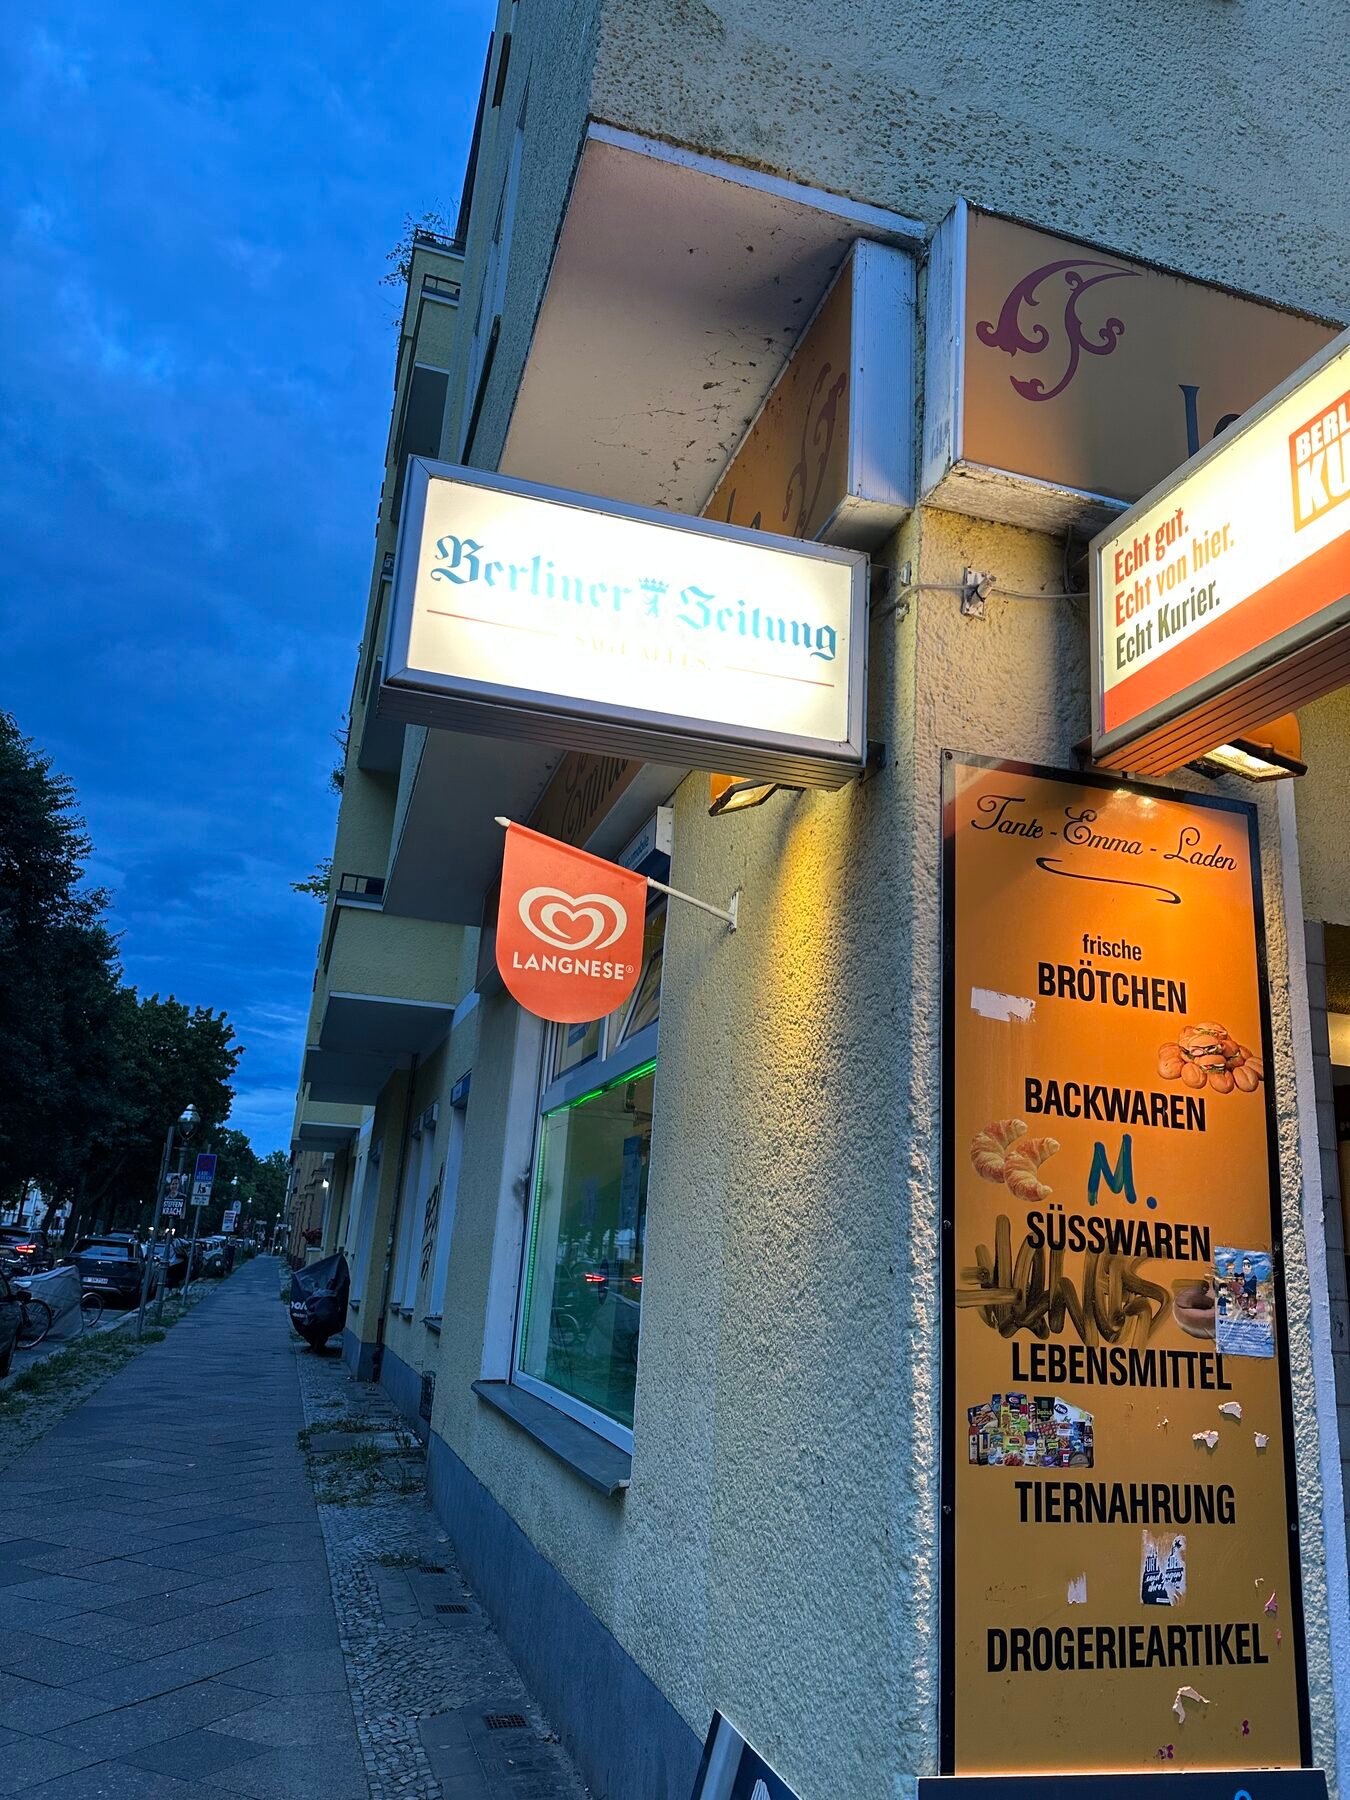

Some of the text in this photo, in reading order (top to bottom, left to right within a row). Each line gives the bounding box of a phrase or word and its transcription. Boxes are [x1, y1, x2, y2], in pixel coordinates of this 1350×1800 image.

[1296, 401, 1350, 465] BERL
[1297, 432, 1350, 521] KU
[1114, 507, 1189, 586] Echt gut.
[1115, 521, 1235, 628] Echt von hier.
[430, 534, 838, 662] Berliner Zeitung
[1116, 579, 1220, 671] Echt Kurier.
[971, 794, 1043, 839] Tante
[1063, 806, 1143, 855] Emma
[1163, 826, 1237, 871] Laden
[1082, 933, 1142, 961] frische
[1037, 960, 1187, 1015] BRÖTCHEN
[1024, 1077, 1206, 1132] BACKWAREN
[1026, 1203, 1211, 1262] SÜSSWAREN
[1012, 1341, 1232, 1391] LEBENSMITTEL
[1014, 1480, 1236, 1525] TIERNAHRUNG
[986, 1622, 1269, 1673] DROGERIEARTIKEL
